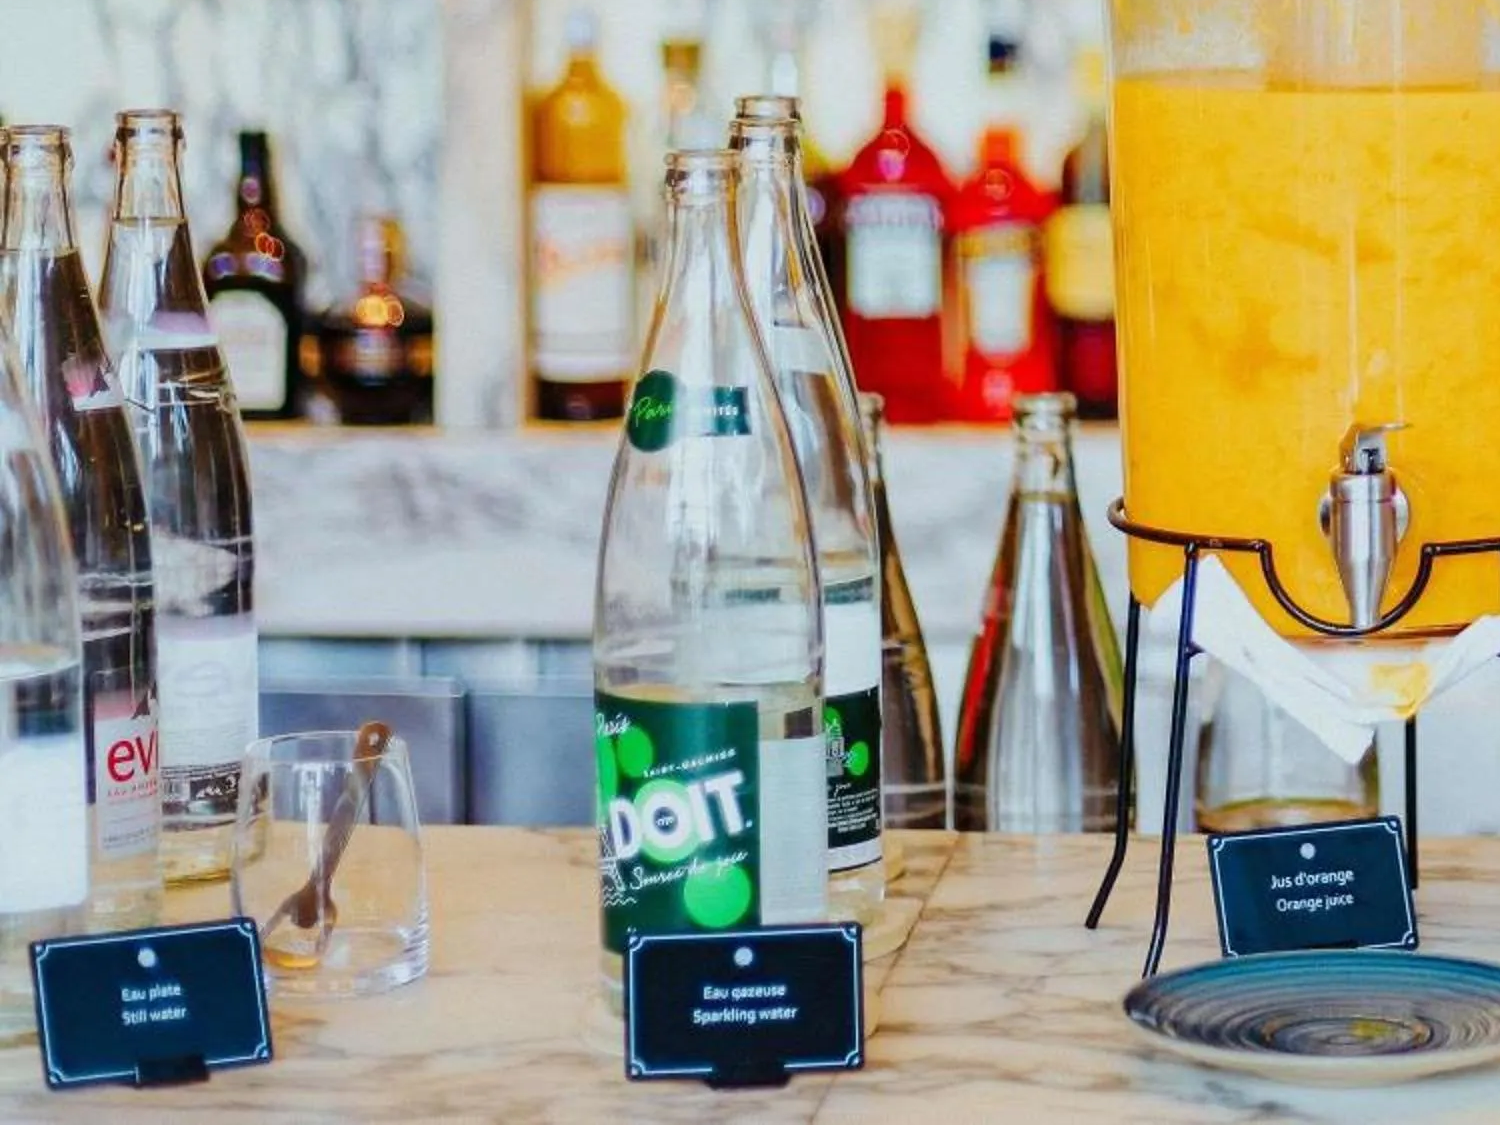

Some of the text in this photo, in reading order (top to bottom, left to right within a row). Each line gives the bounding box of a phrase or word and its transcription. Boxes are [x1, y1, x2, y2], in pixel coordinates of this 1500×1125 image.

[1270, 869, 1355, 890] Jus d'orange
[1276, 893, 1355, 913] Orange juice
[121, 982, 182, 1003] Eau plate
[702, 983, 787, 1002] Eau gazeuse
[121, 1006, 188, 1026] Still water
[692, 1006, 799, 1026] Sparkling water
